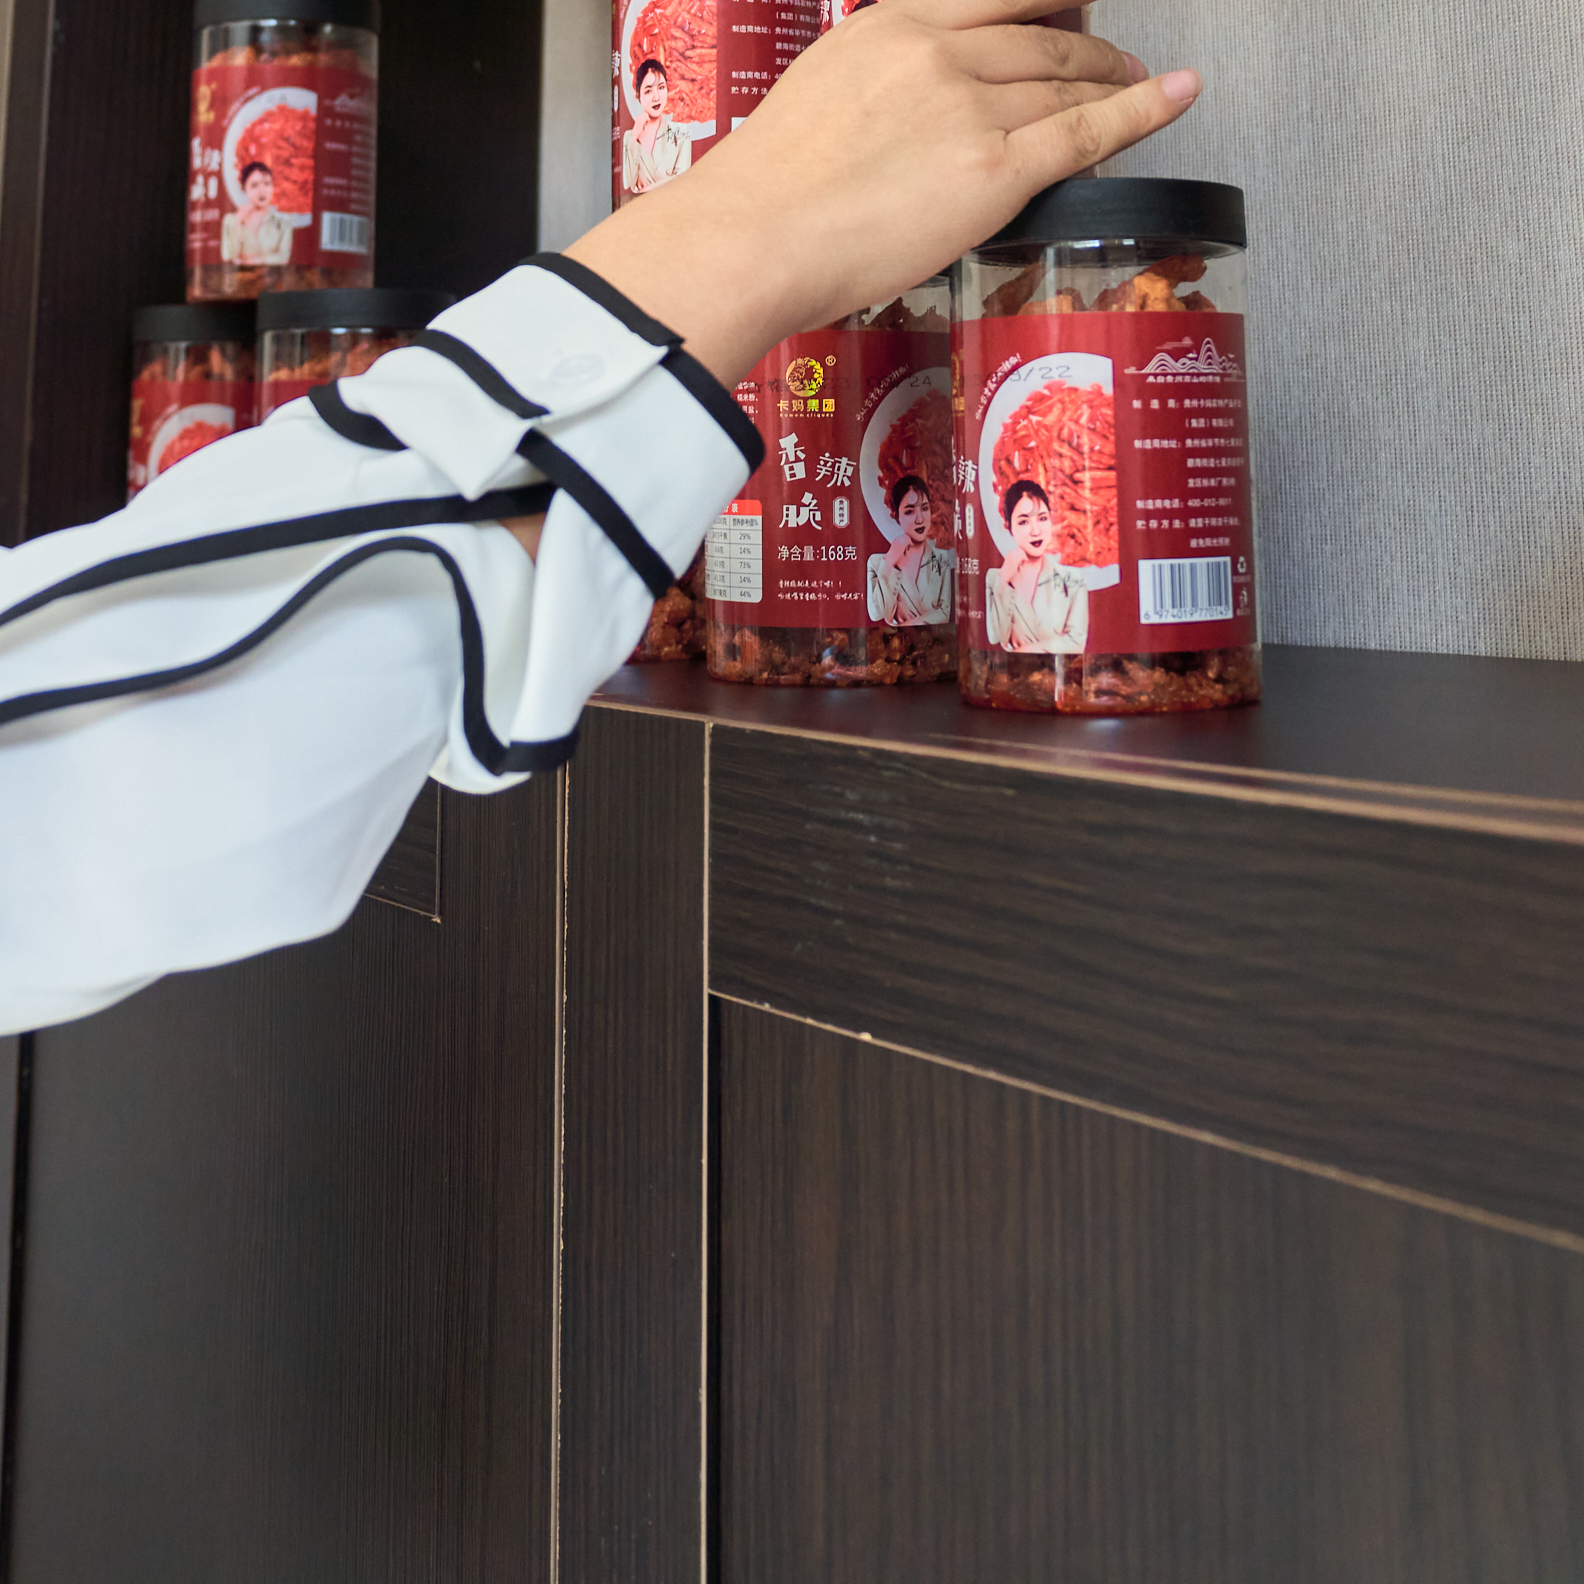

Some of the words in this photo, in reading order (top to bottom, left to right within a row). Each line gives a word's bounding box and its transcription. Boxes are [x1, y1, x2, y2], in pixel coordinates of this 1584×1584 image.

[777, 398, 835, 412] 卡妈集团
[778, 432, 857, 488] 香辣
[779, 491, 823, 530] 脆
[739, 532, 751, 540] 29%
[739, 547, 751, 555] 14%
[739, 561, 751, 569] 73%
[739, 576, 751, 584] 14%
